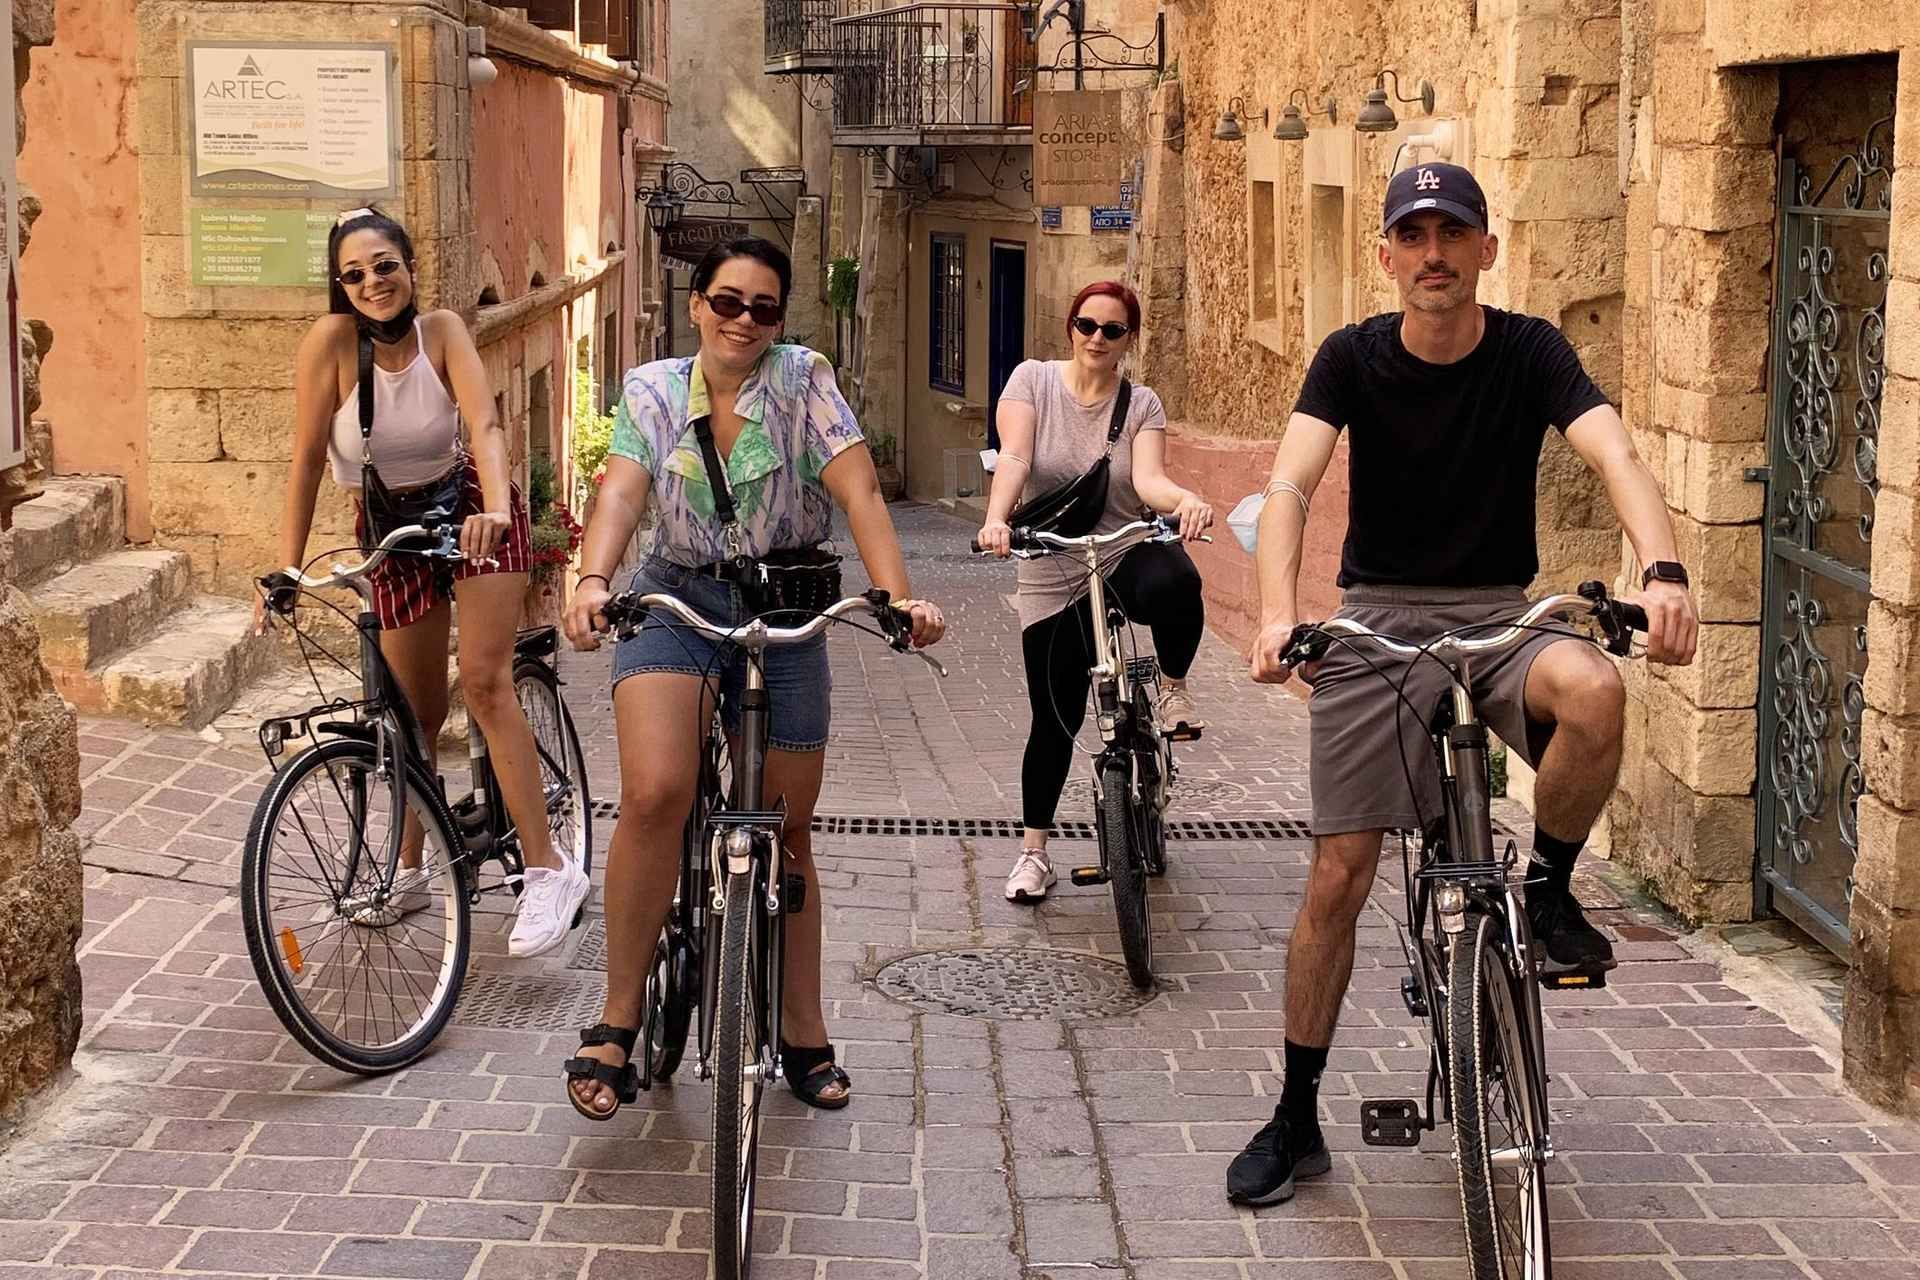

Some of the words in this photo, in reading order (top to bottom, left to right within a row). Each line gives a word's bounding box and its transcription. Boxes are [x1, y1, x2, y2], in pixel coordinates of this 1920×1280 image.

[203, 80, 287, 100] ARTEC
[1053, 113, 1101, 130] ARIA
[1040, 131, 1116, 148] concept
[1053, 149, 1101, 163] STORE
[201, 182, 310, 192] www.artechomes.com
[1415, 167, 1441, 191] LA
[668, 222, 735, 247] FAGOTTO
